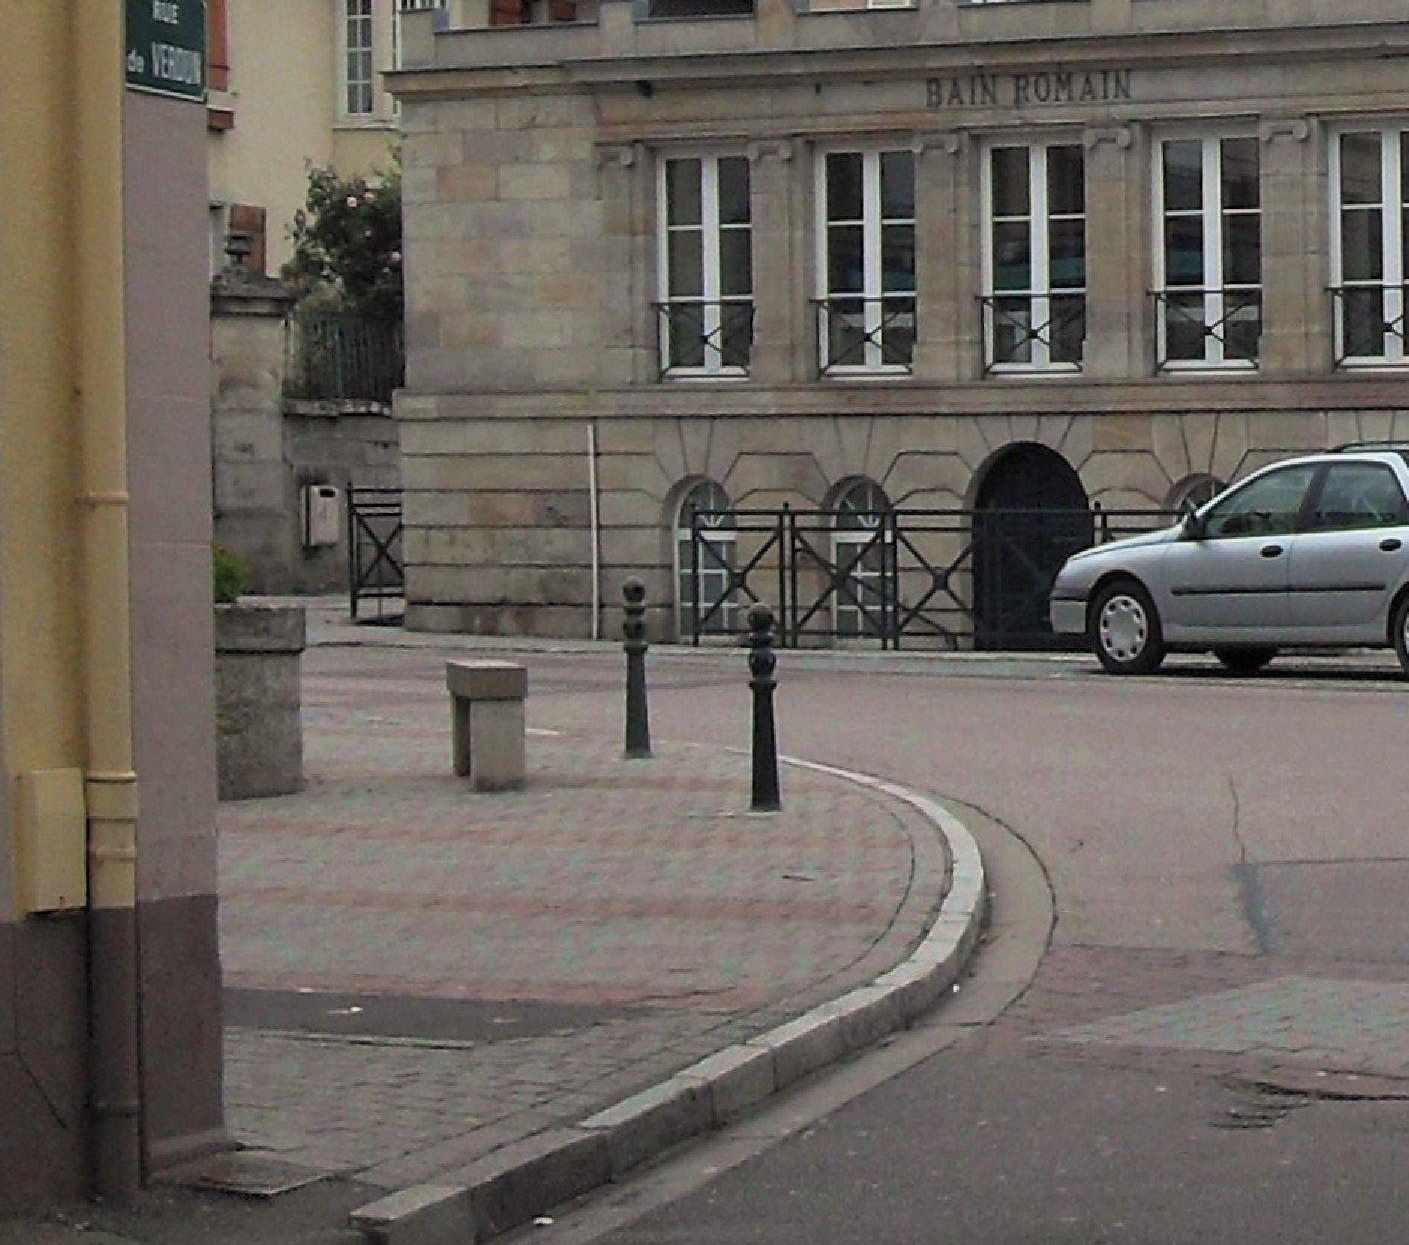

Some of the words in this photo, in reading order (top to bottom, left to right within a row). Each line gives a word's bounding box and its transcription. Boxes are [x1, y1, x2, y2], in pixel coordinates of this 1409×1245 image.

[152, 0, 179, 24] RUE
[127, 46, 145, 73] de
[151, 41, 201, 85] VERDUN
[926, 74, 997, 108] BAIN
[1013, 68, 1131, 107] ROMAIN
